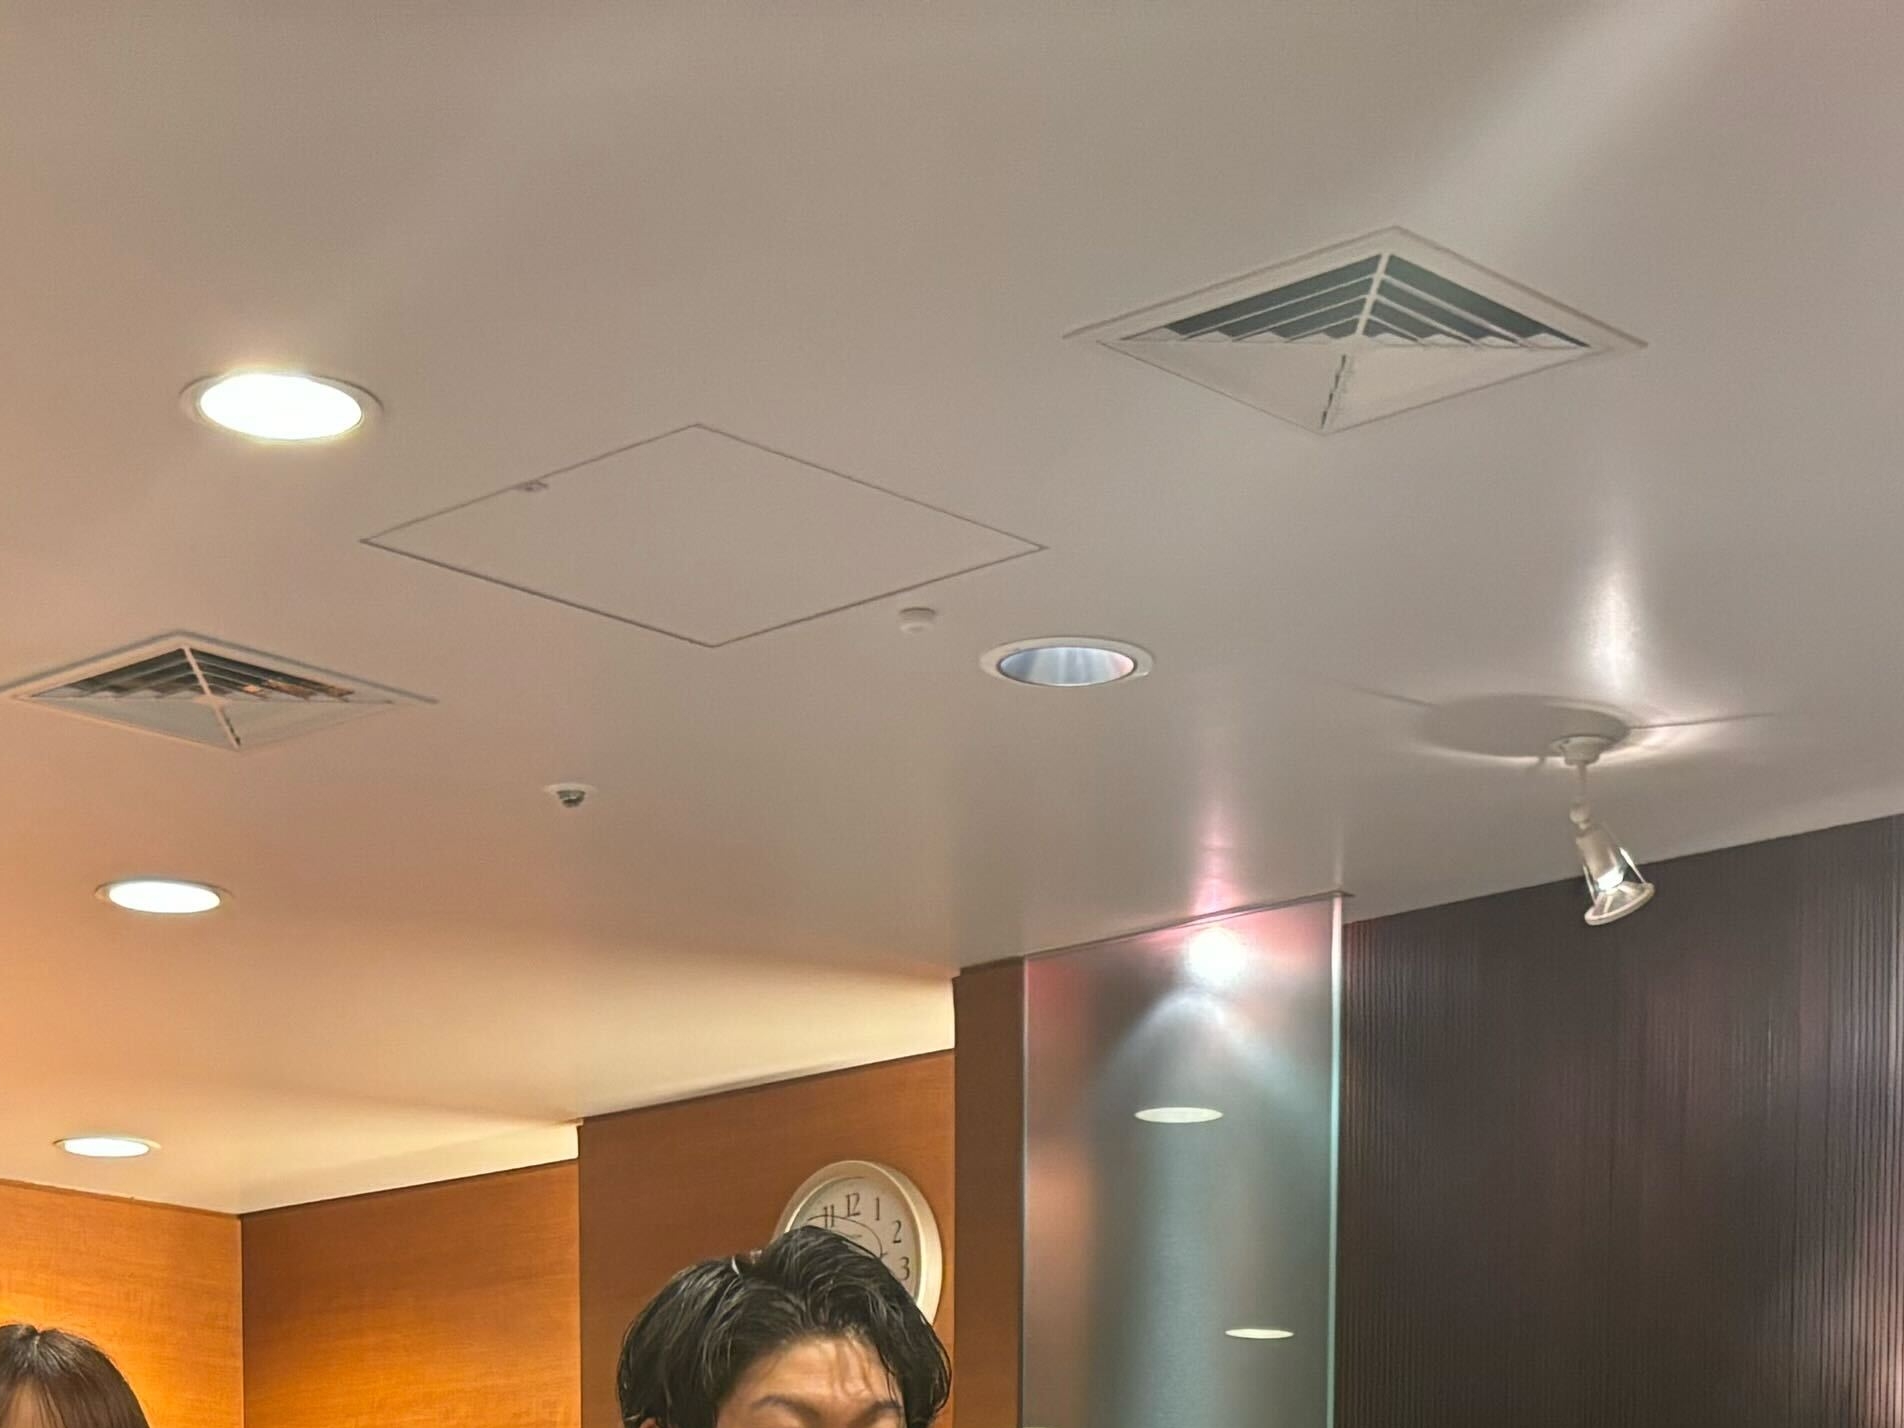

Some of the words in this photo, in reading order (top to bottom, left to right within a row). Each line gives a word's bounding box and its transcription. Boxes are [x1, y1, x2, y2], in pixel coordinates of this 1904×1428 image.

[823, 1204, 835, 1230] 11
[846, 1192, 861, 1218] 12
[874, 1196, 881, 1222] 1
[892, 1220, 902, 1244] 2
[900, 1256, 911, 1281] 3
